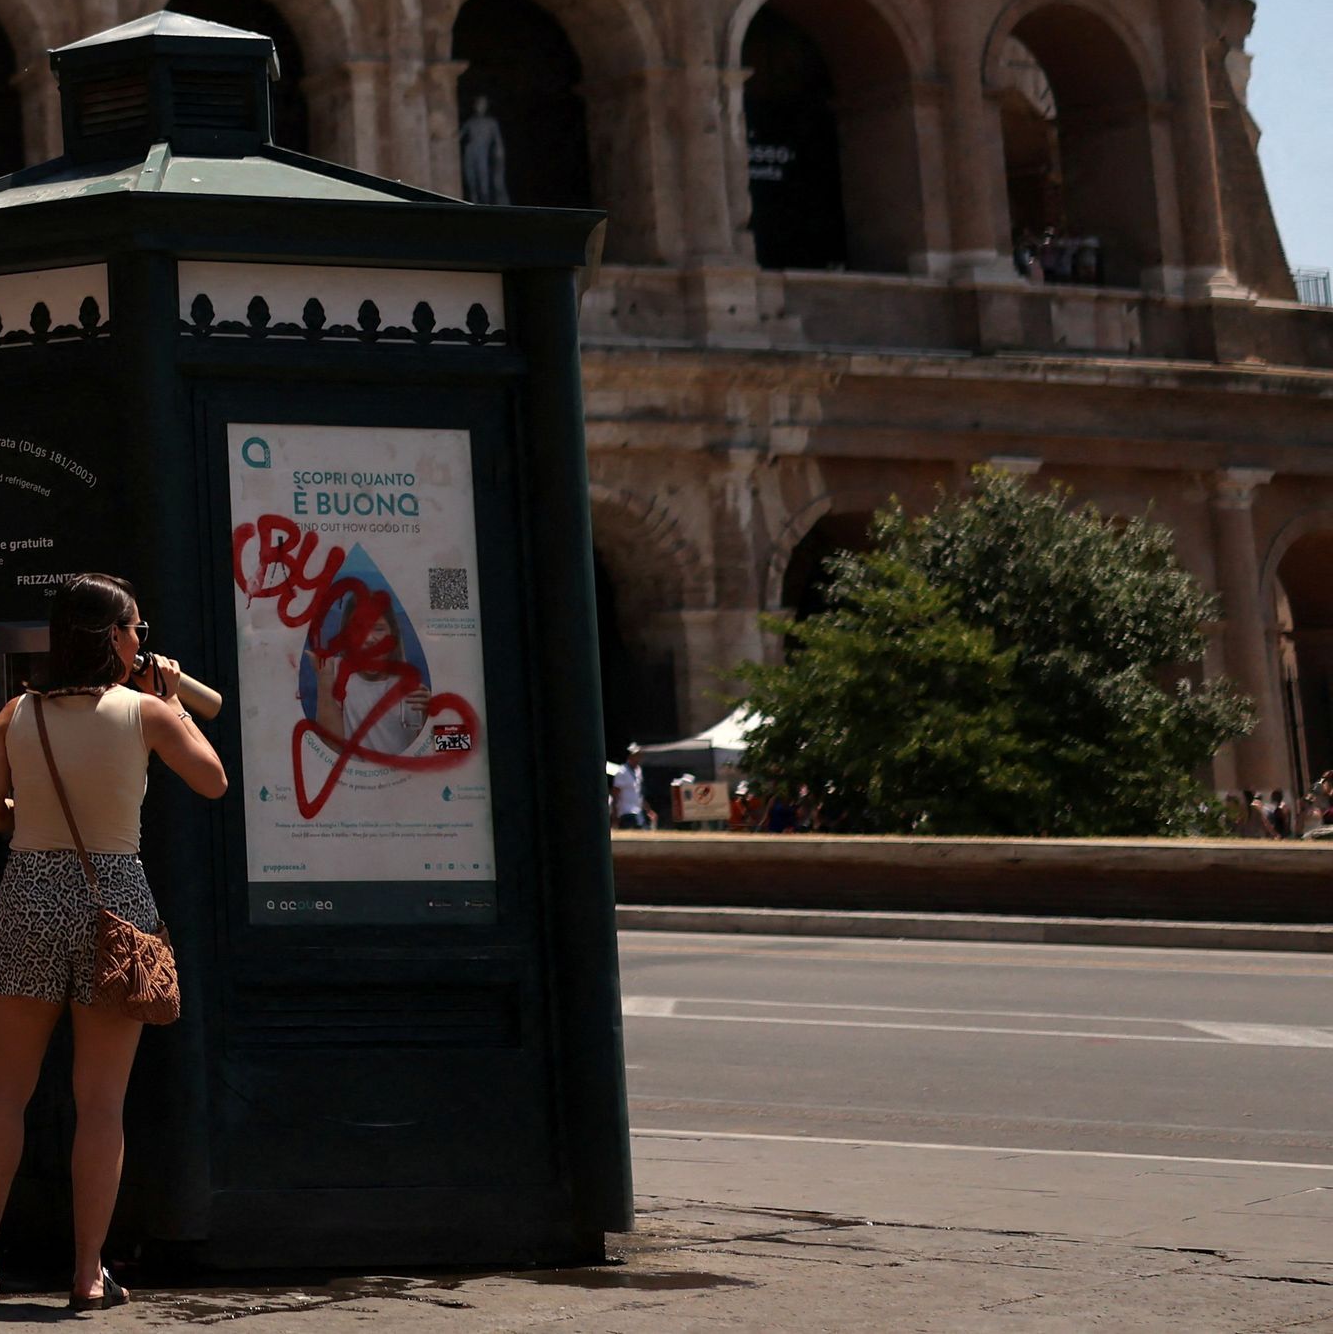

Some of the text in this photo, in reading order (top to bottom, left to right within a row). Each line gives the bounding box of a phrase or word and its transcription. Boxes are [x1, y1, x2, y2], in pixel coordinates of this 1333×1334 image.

[18, 440, 47, 459] (DLgs
[48, 450, 98, 489] 181/2003)
[5, 475, 51, 497] refrigerated
[293, 471, 415, 487] SCOPRI QUANTO
[293, 485, 308, 515] È
[320, 522, 341, 532] OUT
[343, 522, 368, 533] HOW
[368, 522, 400, 533] GOOD
[401, 523, 410, 533] IT
[411, 523, 421, 533] IS
[9, 537, 54, 552] gratuita
